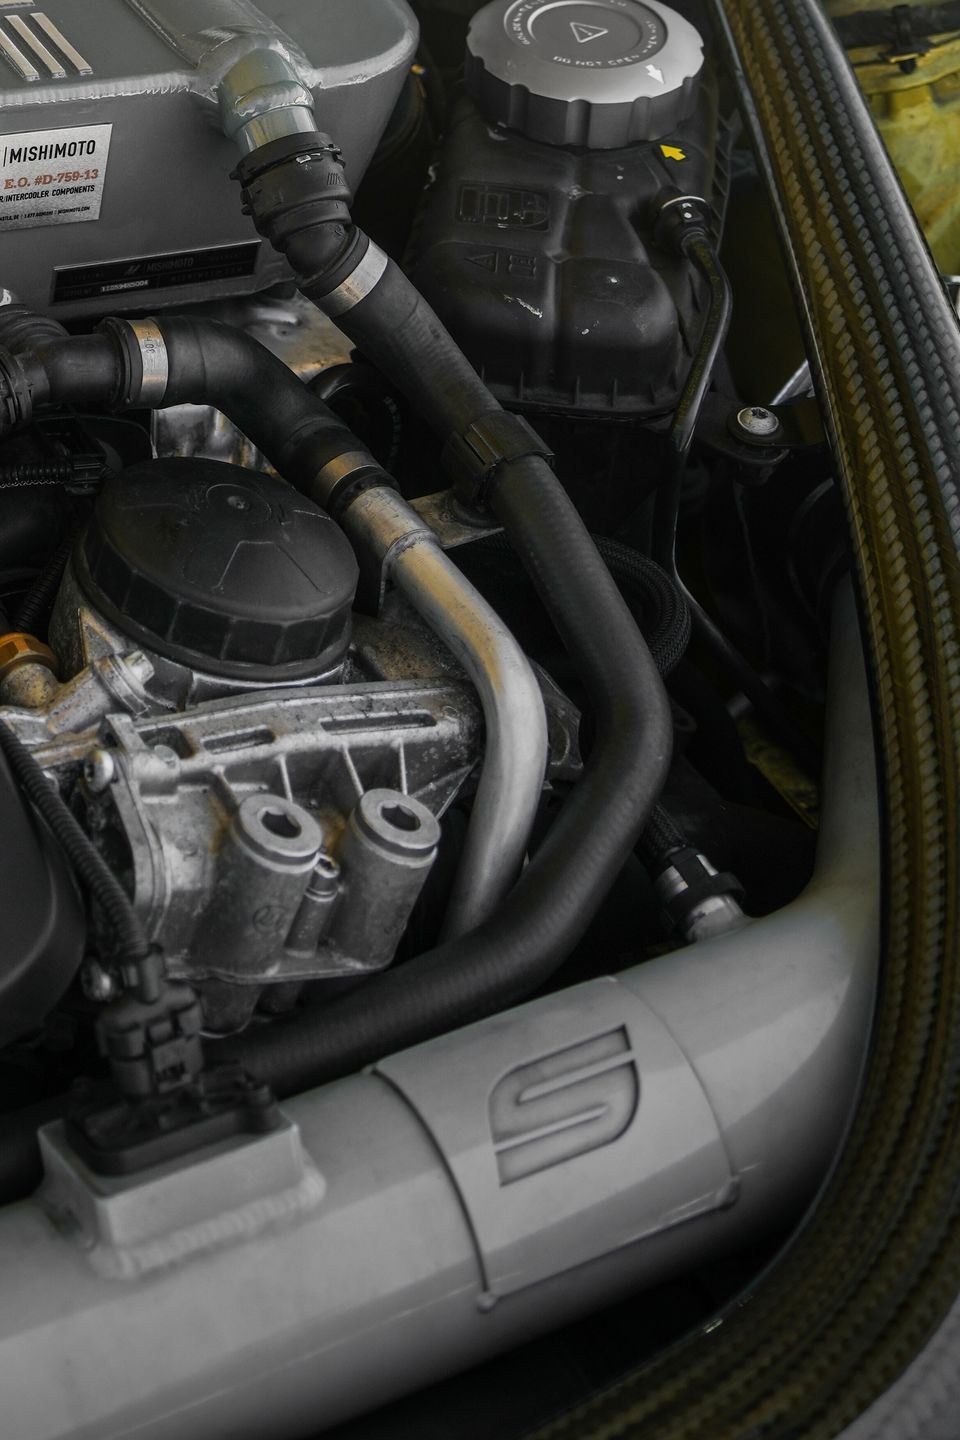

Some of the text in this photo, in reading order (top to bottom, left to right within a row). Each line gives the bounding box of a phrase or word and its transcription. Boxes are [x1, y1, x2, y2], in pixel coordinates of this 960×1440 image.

[9, 140, 96, 164] MISHIMOTO
[4, 177, 31, 189] E.O.
[34, 169, 99, 186] #D-759-13
[52, 185, 95, 197] COMPONENTS
